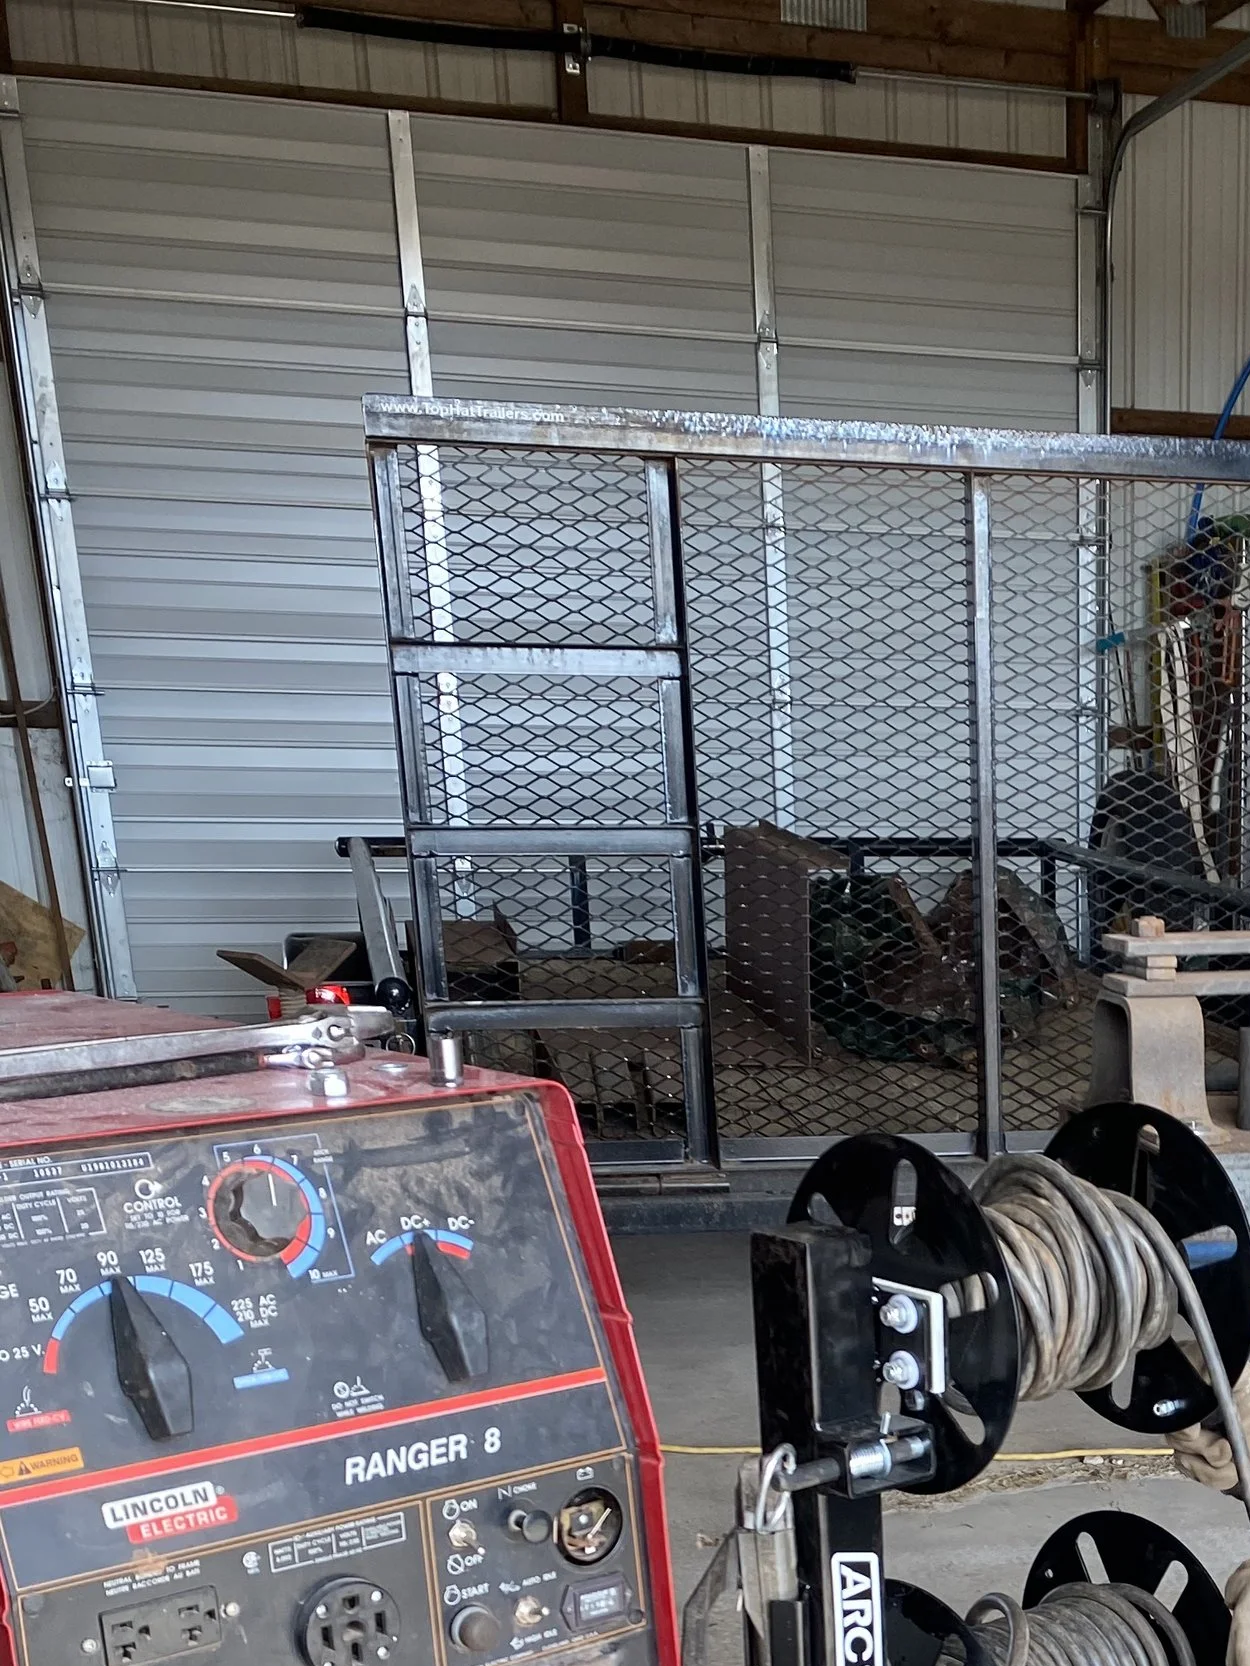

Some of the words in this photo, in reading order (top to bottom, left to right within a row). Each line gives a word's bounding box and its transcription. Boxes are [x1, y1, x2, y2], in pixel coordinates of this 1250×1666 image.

[380, 401, 565, 423] www.TopHatTrailers.com
[222, 1151, 231, 1162] 5
[253, 1145, 262, 1155] 6
[290, 1154, 298, 1165] 7
[202, 1174, 210, 1186] 4
[318, 1187, 327, 1198] 8
[123, 1196, 182, 1214] CONTROL
[199, 1207, 207, 1218] 3
[401, 1215, 431, 1230] DC+
[448, 1216, 475, 1230] DC-
[326, 1227, 335, 1238] 9
[365, 1230, 387, 1246] AC
[211, 1238, 221, 1250] 2
[97, 1251, 118, 1267] 90
[139, 1248, 166, 1265] 125
[100, 1265, 122, 1275] MAX
[145, 1262, 167, 1273] MAX
[189, 1262, 214, 1277] 175
[237, 1259, 245, 1271] 1
[56, 1268, 78, 1285] 70
[194, 1275, 216, 1286] MAX
[309, 1269, 320, 1280] 10
[59, 1282, 82, 1294] MAX
[28, 1296, 50, 1314] 50
[231, 1298, 253, 1312] 225
[259, 1294, 277, 1306] AC
[31, 1311, 54, 1323] MAX
[236, 1309, 257, 1322] 210
[260, 1305, 279, 1318] DC
[250, 1317, 271, 1328] MAX
[13, 1346, 30, 1360] 25
[30, 1453, 79, 1471] WARNING
[344, 1433, 469, 1486] RANGER
[483, 1427, 502, 1454] 8
[109, 1486, 210, 1523] LINCOLN
[459, 1498, 478, 1513] ON
[139, 1505, 229, 1540] ELECTRIC
[522, 1575, 542, 1586] AUTO
[460, 1582, 490, 1600] START
